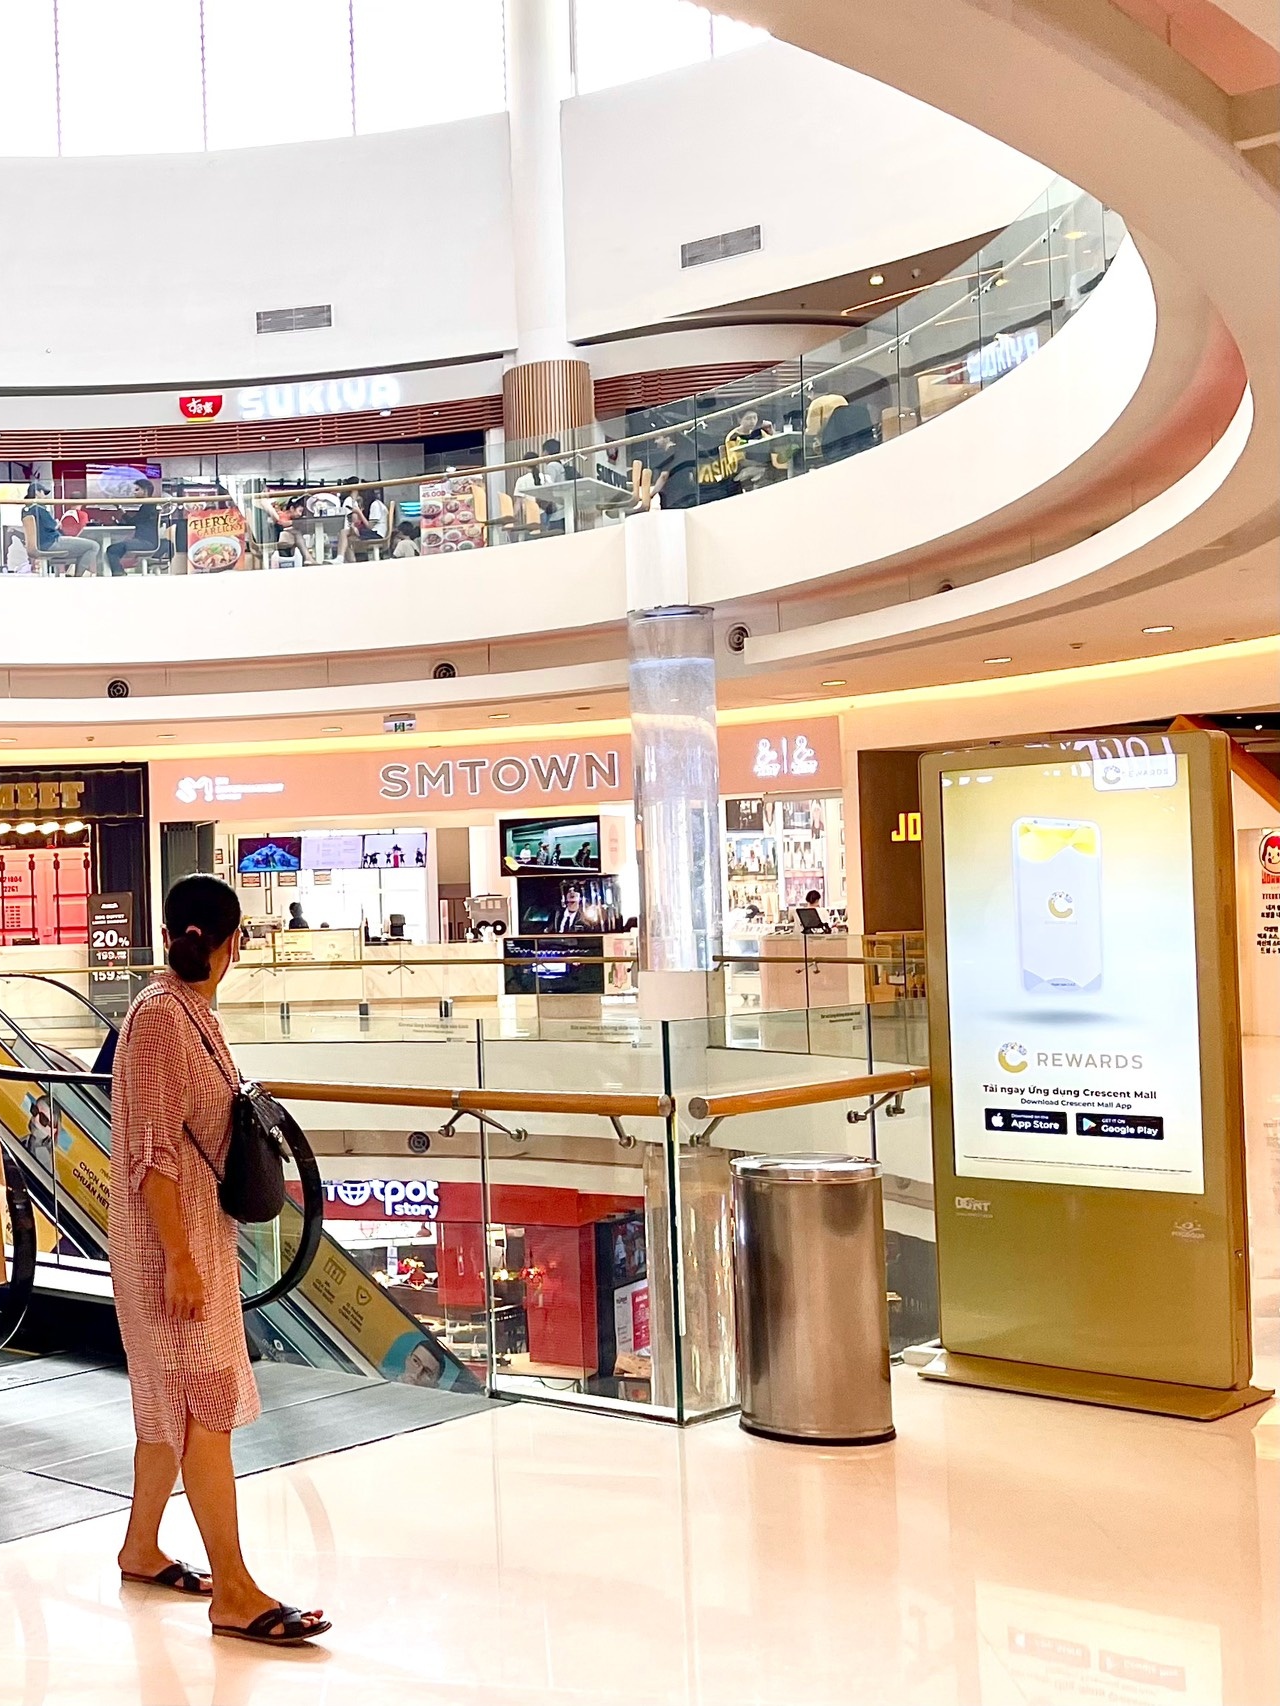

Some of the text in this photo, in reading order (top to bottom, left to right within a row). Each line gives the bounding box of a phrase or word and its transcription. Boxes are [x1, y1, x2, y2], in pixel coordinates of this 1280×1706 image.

[236, 375, 402, 420] SUKIYA
[189, 514, 229, 531] FIERY
[380, 751, 618, 799] SMTOWN
[92, 929, 130, 948] 20%
[1037, 1052, 1143, 1069] REWARDS
[1001, 1086, 1026, 1096] ngay
[1052, 1087, 1080, 1098] dụng
[1082, 1088, 1131, 1099] Crescent
[1134, 1090, 1157, 1099] Mall
[1020, 1098, 1060, 1106] Download
[1060, 1099, 1095, 1107] Crescent
[1115, 1102, 1133, 1110] App
[1011, 1119, 1060, 1130] App Store
[1101, 1124, 1159, 1137] Google Play
[393, 1202, 439, 1219] story
